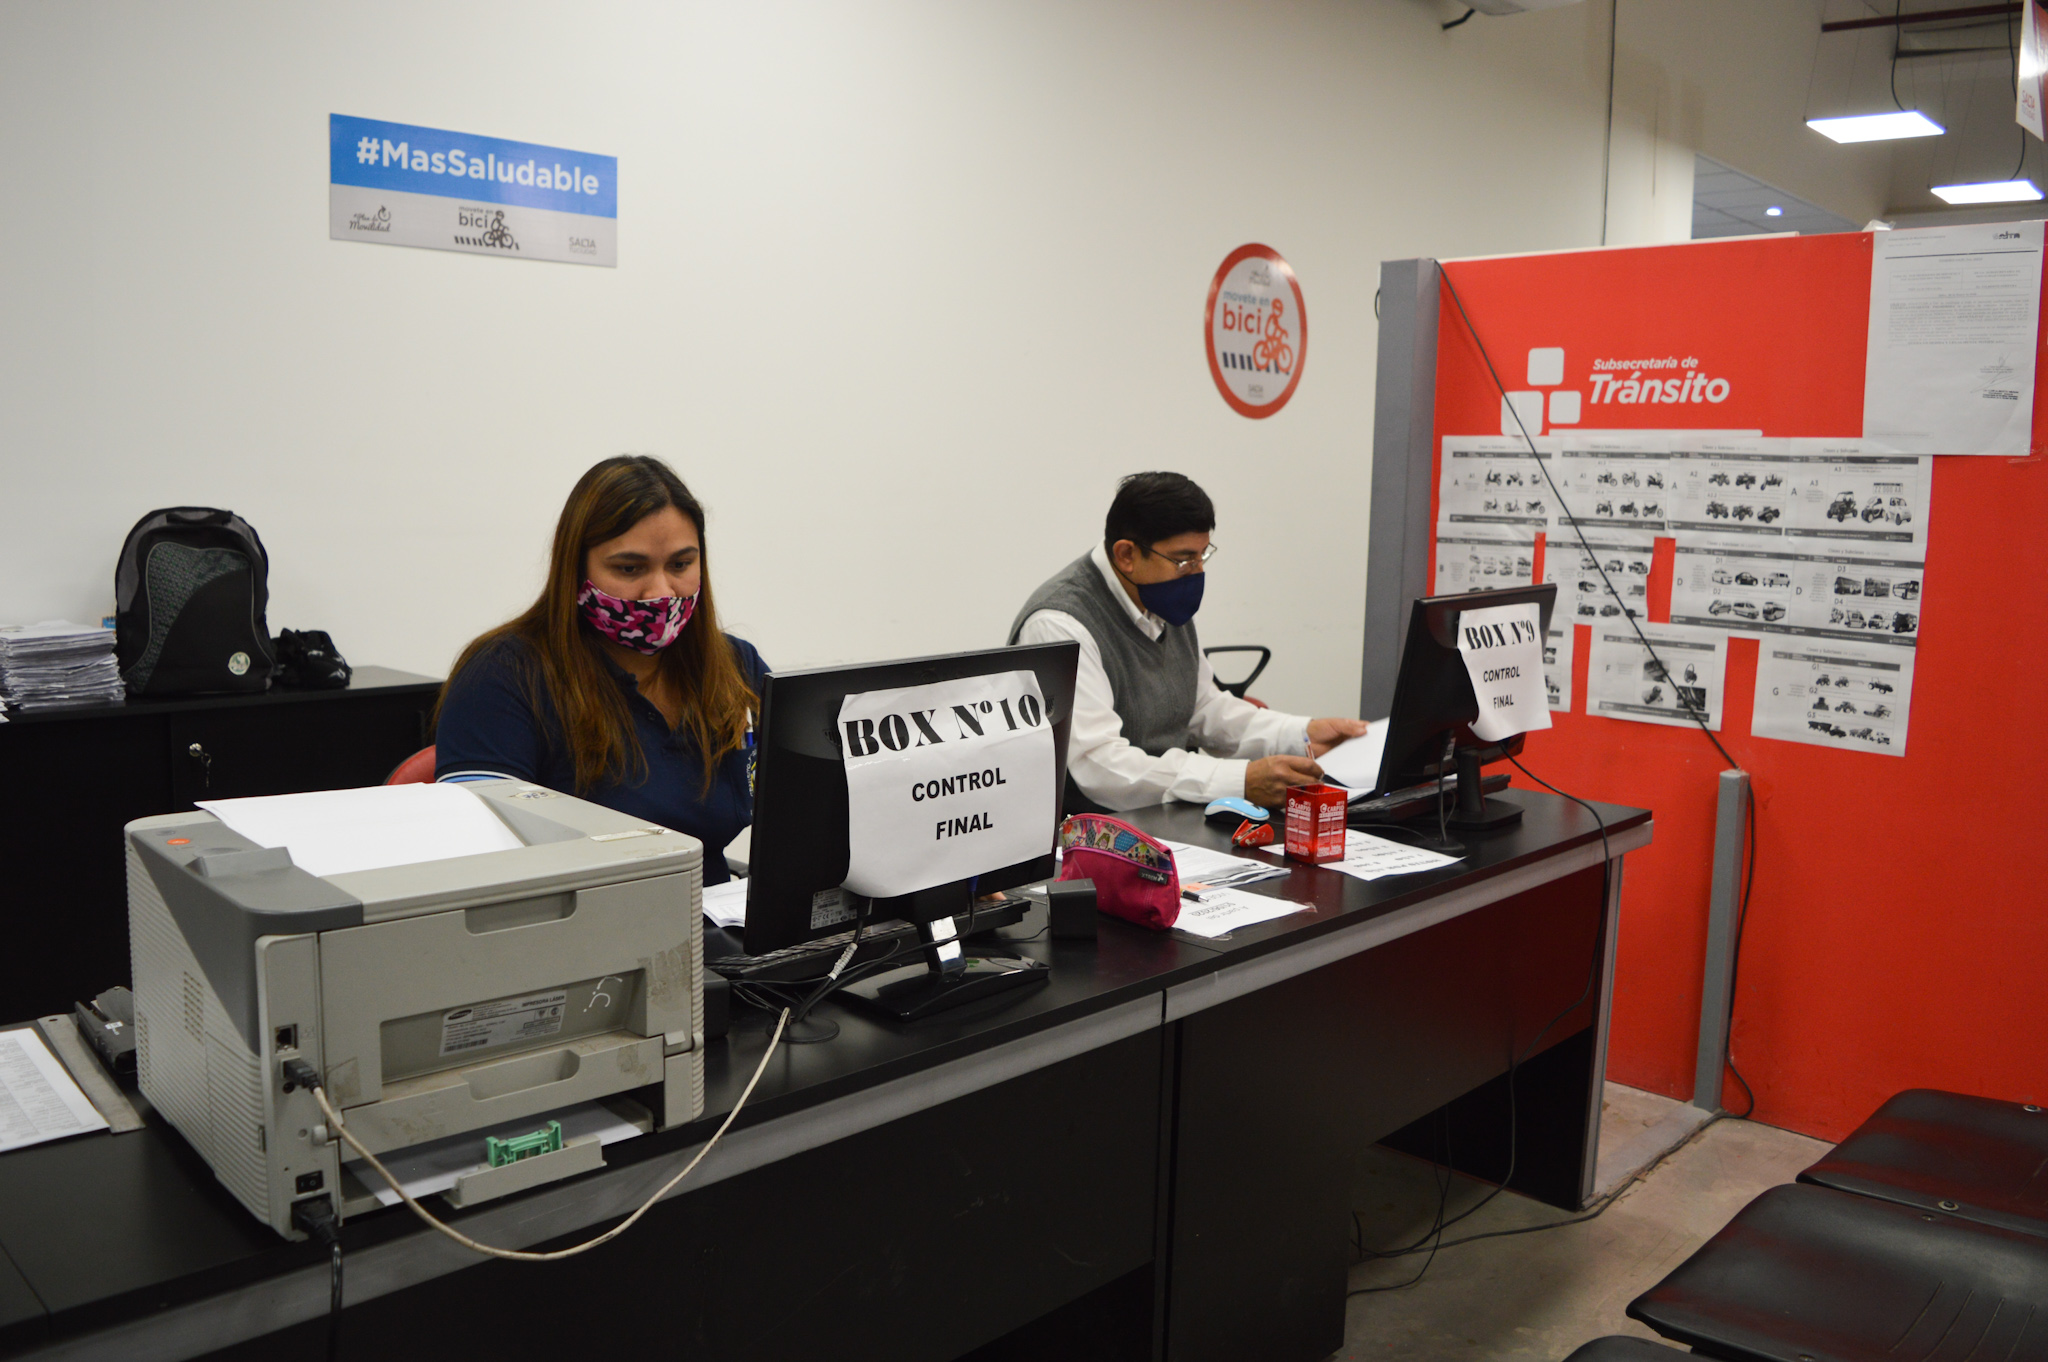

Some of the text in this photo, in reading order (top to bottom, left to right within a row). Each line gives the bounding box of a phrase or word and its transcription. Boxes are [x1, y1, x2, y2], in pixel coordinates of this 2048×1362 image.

[357, 136, 599, 195] #MasSaludable
[459, 211, 488, 229] bici
[1223, 290, 1256, 304] movete
[1222, 302, 1262, 335] bici
[1593, 356, 1699, 370] Subsecretaría de
[1589, 371, 1730, 404] Tránsito
[1809, 479, 1819, 487] A3
[1791, 487, 1797, 496] A
[1547, 573, 1552, 581] C
[1796, 586, 1802, 595] D
[1464, 622, 1507, 650] BOX
[1483, 666, 1520, 682] CONTROL
[1772, 687, 1779, 695] G
[1493, 694, 1514, 709] FINAL
[843, 708, 945, 758] BOX
[912, 767, 1006, 802] CONTROL
[936, 812, 993, 840] FINAL
